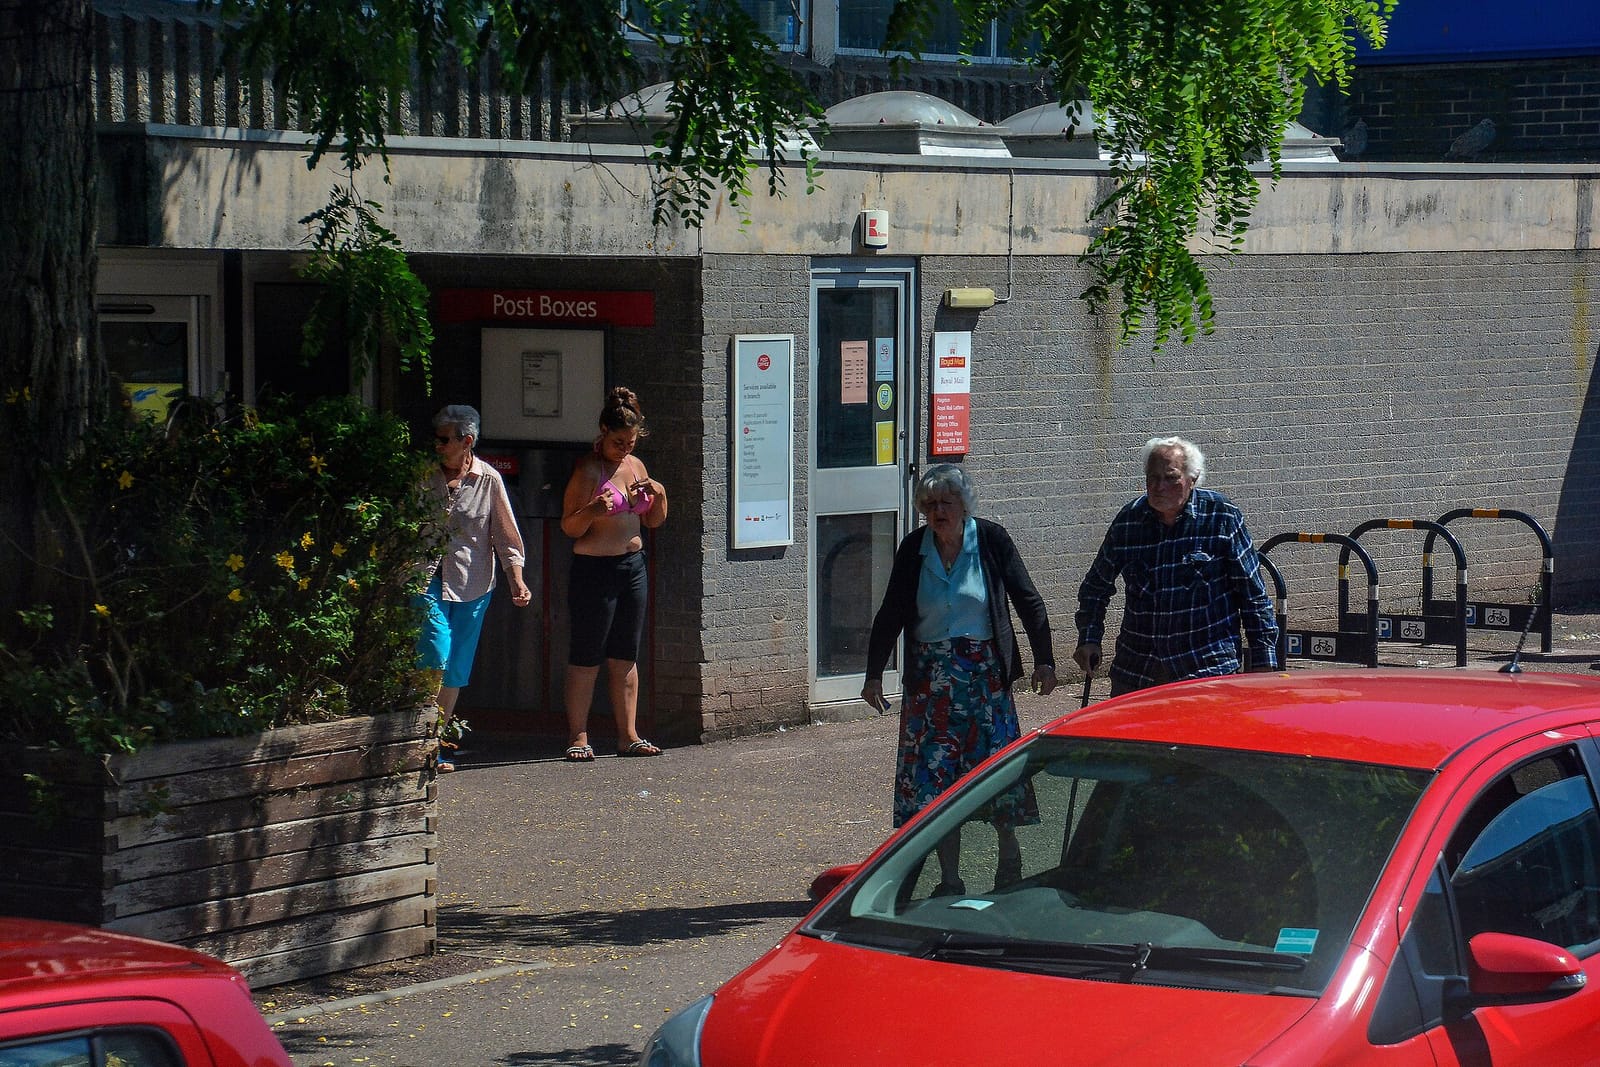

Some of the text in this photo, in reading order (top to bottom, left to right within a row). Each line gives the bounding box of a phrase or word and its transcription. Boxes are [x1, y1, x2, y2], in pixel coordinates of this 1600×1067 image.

[493, 294, 597, 318] Post Boxes
[941, 358, 953, 366] Royal
[1378, 620, 1389, 635] P
[1288, 636, 1299, 652] P
